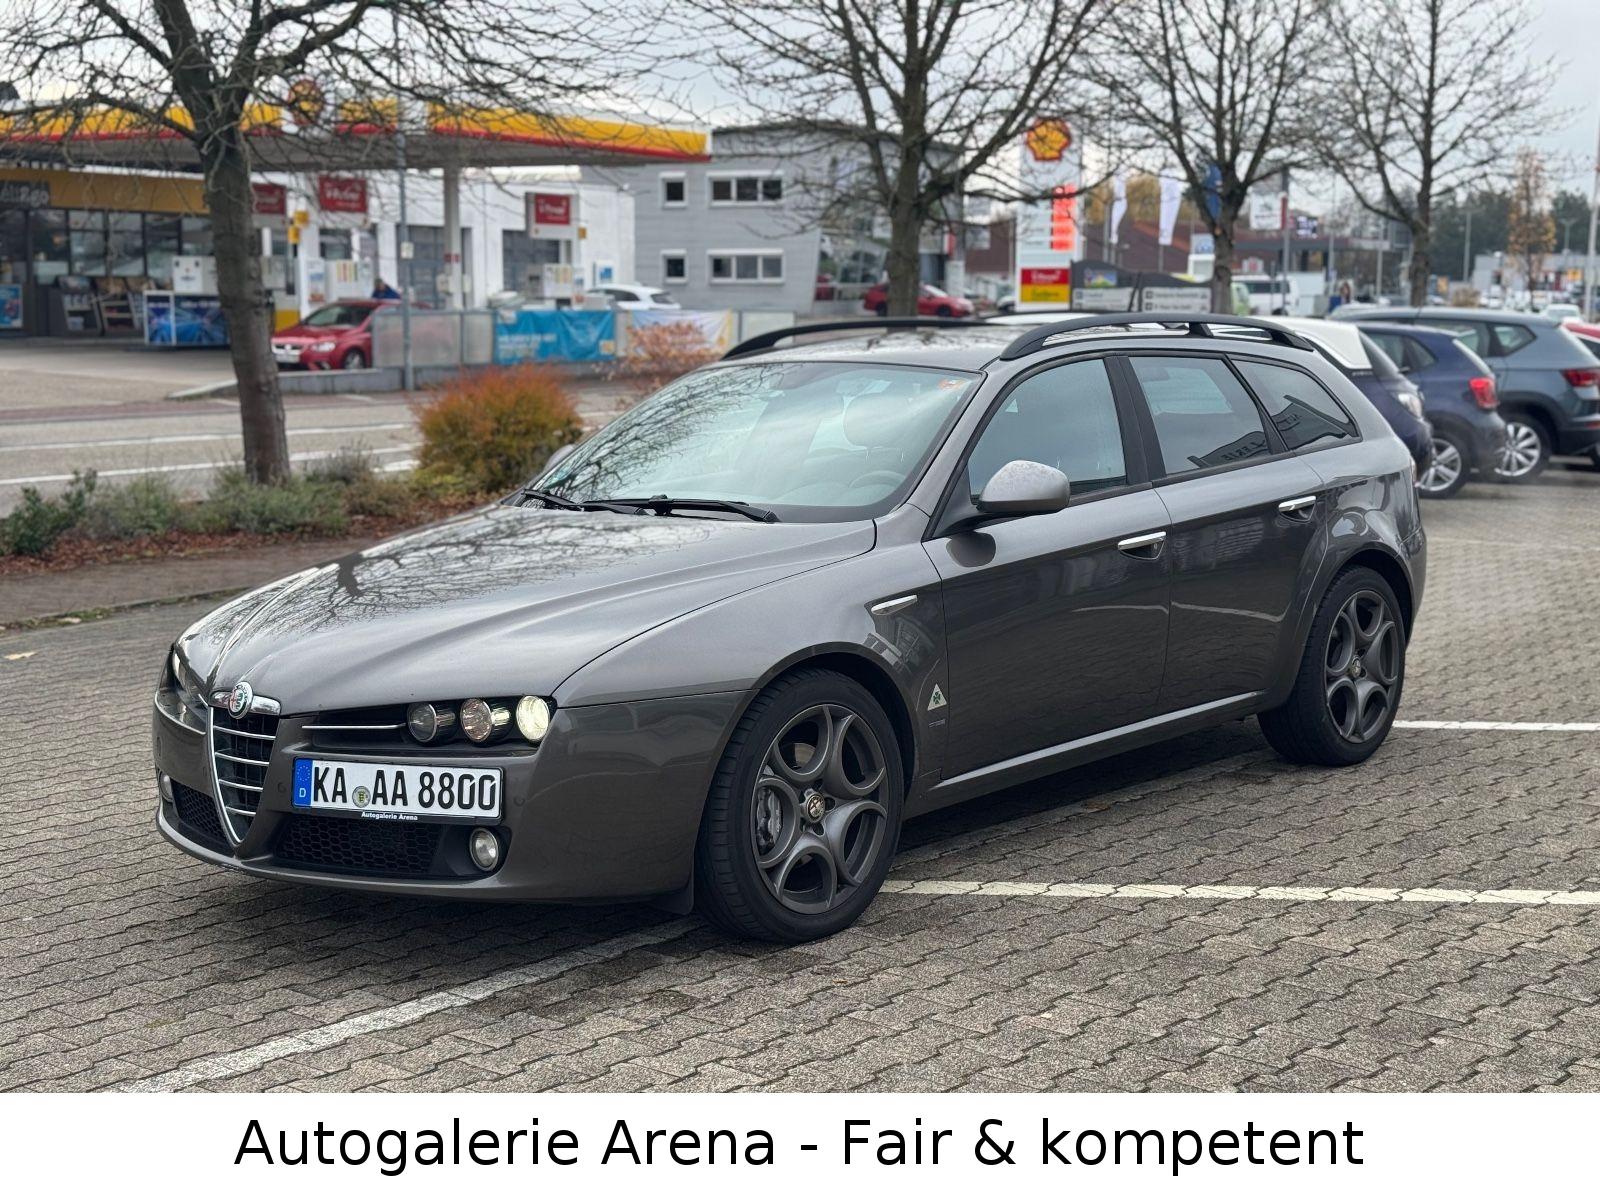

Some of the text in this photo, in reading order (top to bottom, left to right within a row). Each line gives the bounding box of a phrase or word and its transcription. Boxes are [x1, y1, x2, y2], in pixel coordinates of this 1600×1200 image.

[299, 787, 307, 798] D
[313, 766, 496, 811] KA AA 8800
[361, 811, 418, 821] Autogalerie Arena
